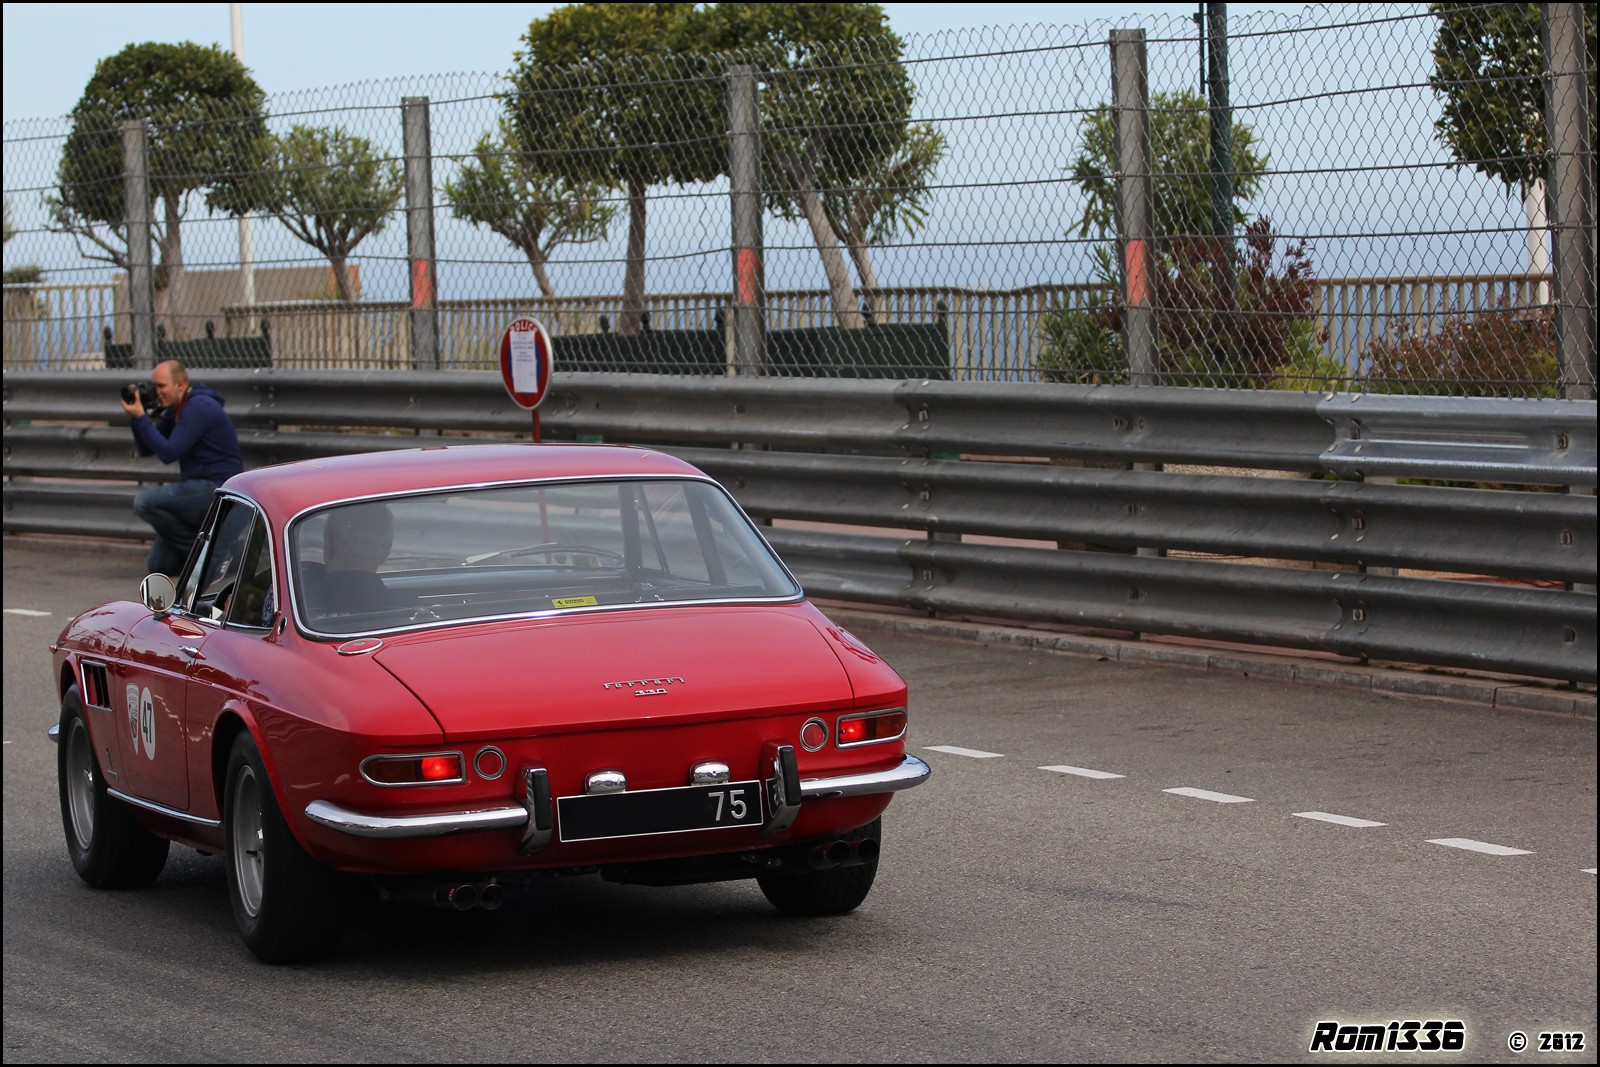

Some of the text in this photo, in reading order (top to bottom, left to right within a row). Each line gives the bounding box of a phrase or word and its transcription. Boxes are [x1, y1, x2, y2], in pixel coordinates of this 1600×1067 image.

[603, 677, 684, 689] Ferrari
[143, 701, 153, 743] 47
[708, 789, 747, 821] 75
